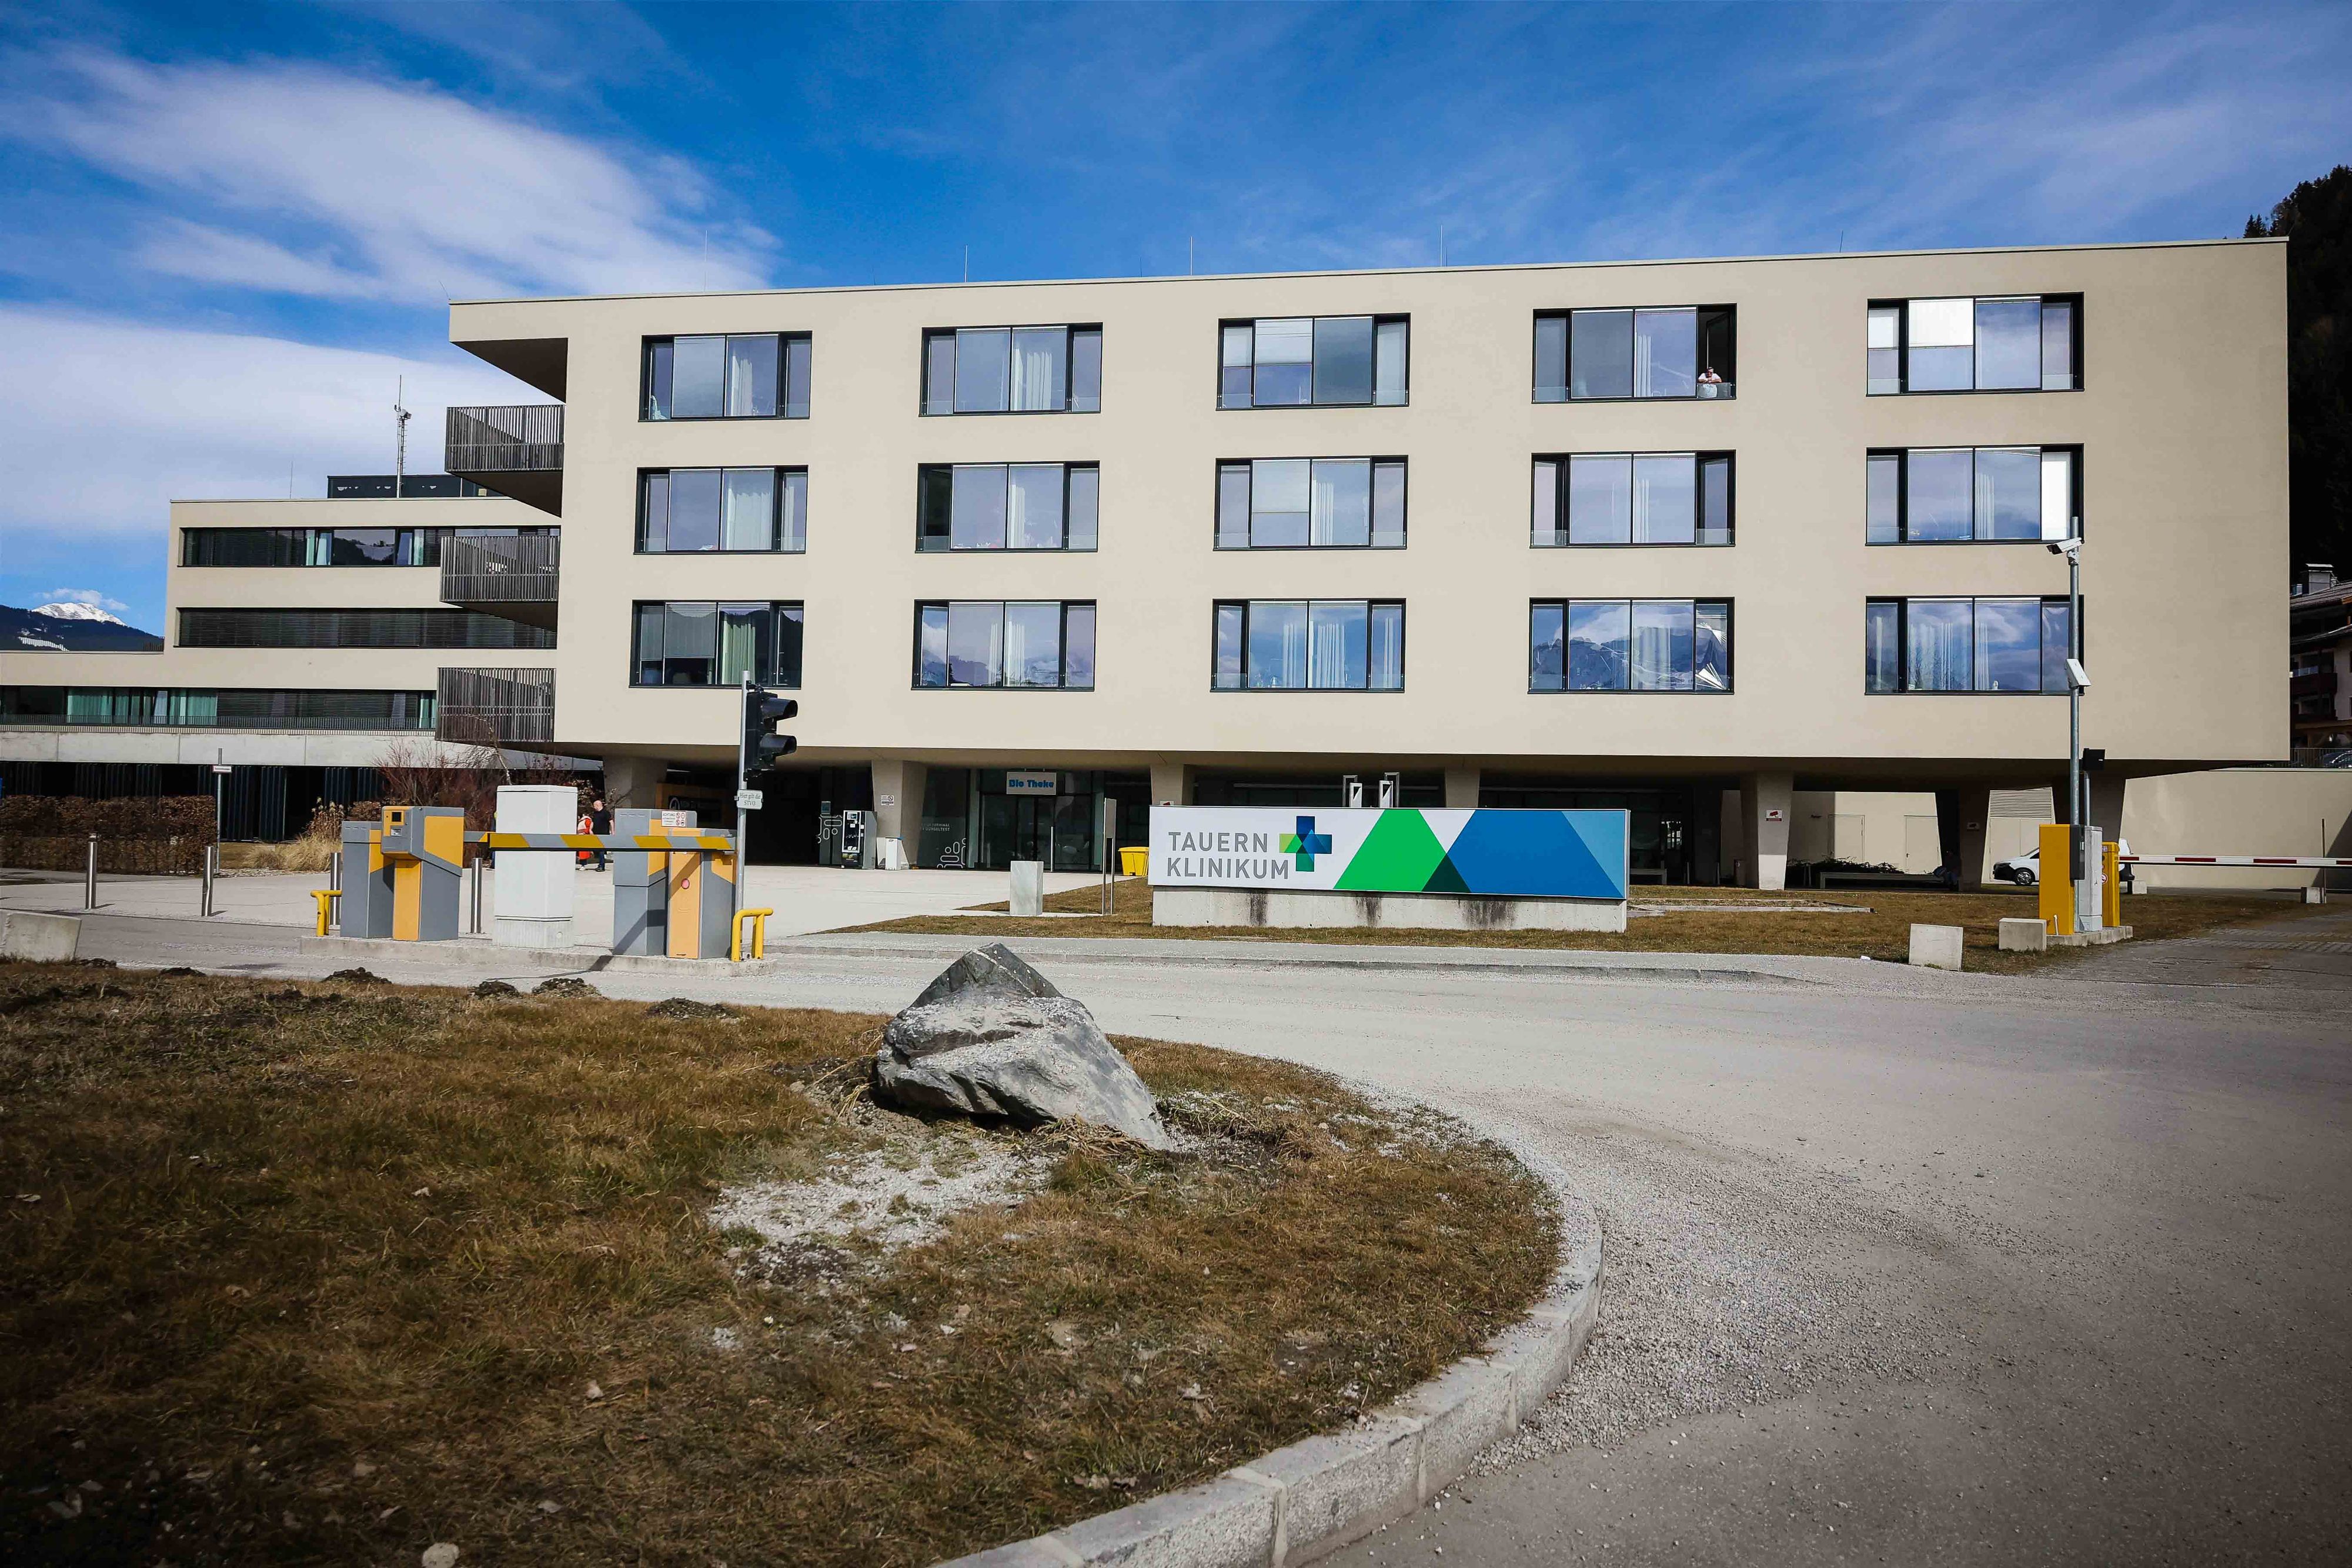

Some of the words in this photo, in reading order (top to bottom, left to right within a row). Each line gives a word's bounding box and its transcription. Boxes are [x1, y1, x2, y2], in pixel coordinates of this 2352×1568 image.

[1027, 780, 1054, 788] Theke
[1168, 832, 1268, 852] TAUERN
[1167, 857, 1288, 880] KLINIKUM
